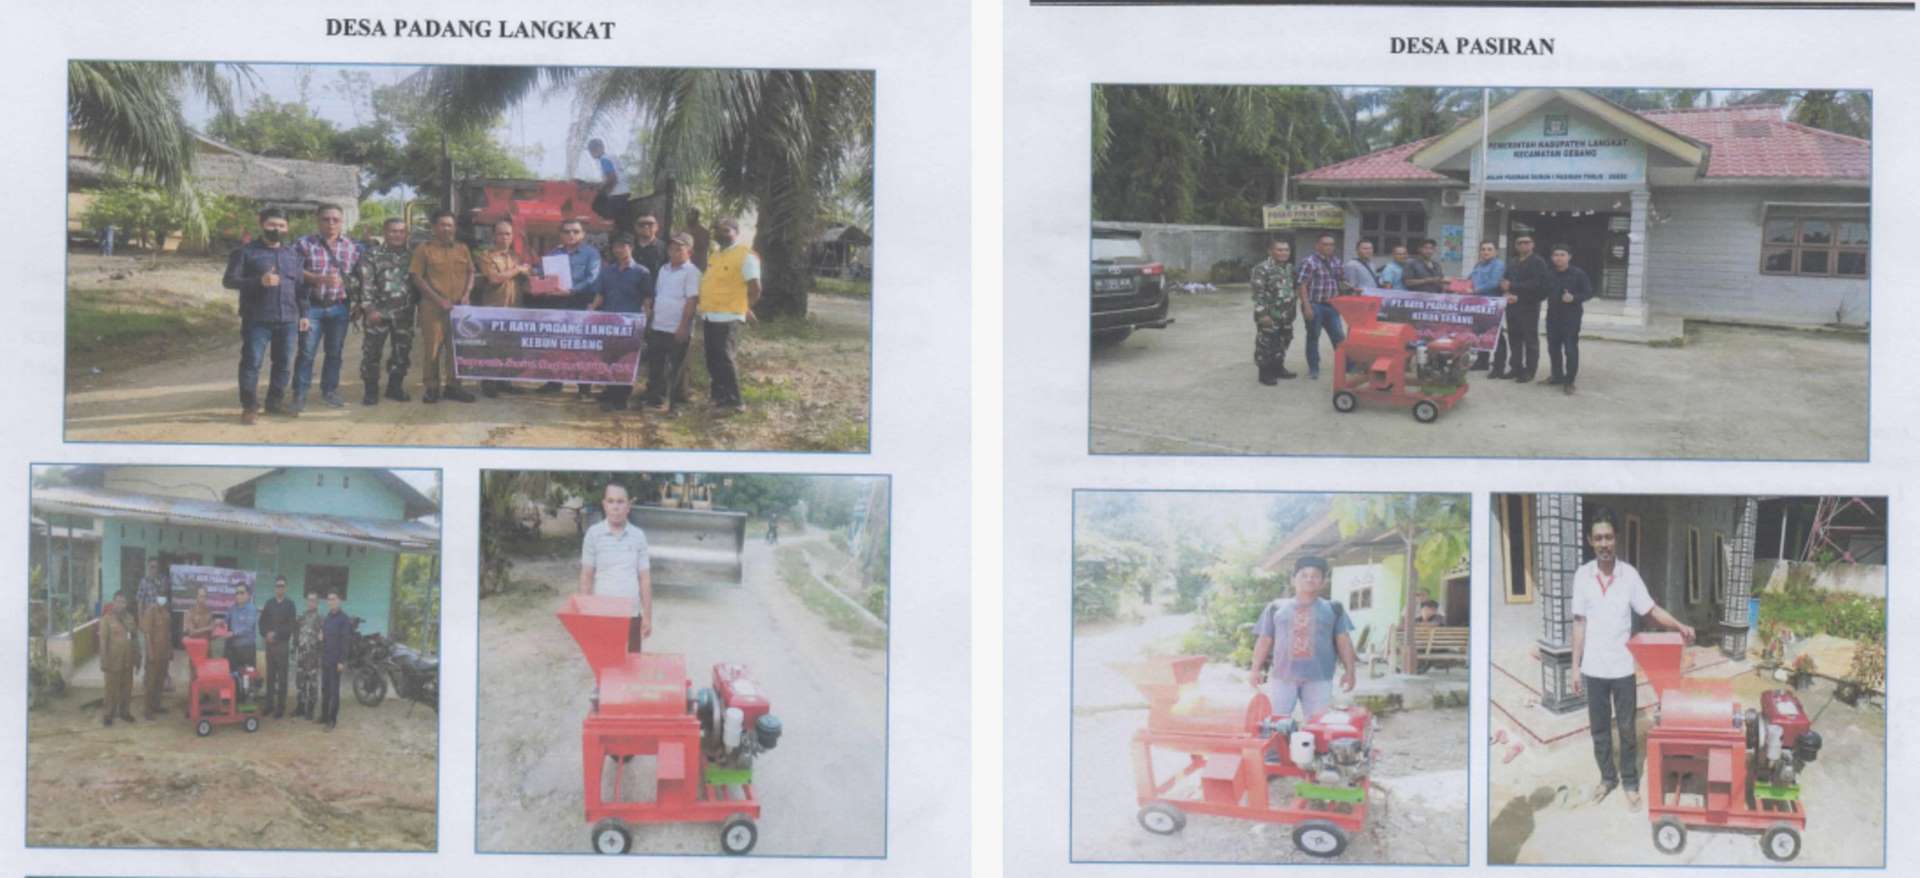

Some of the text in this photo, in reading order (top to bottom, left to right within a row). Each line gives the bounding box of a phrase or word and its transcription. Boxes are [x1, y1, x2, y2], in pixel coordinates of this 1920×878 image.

[326, 18, 616, 40] DESA PADANG LANGKAT
[1390, 36, 1555, 56] DESA PASIRAN
[1539, 139, 1586, 149] KABUPATEN
[1588, 138, 1628, 147] LANGKAT
[1513, 149, 1597, 158] KECAMATAN GEBANG
[491, 321, 633, 337] PT. RAYA PADANG LANGKAT
[520, 337, 603, 350] KEBUN GEBANG
